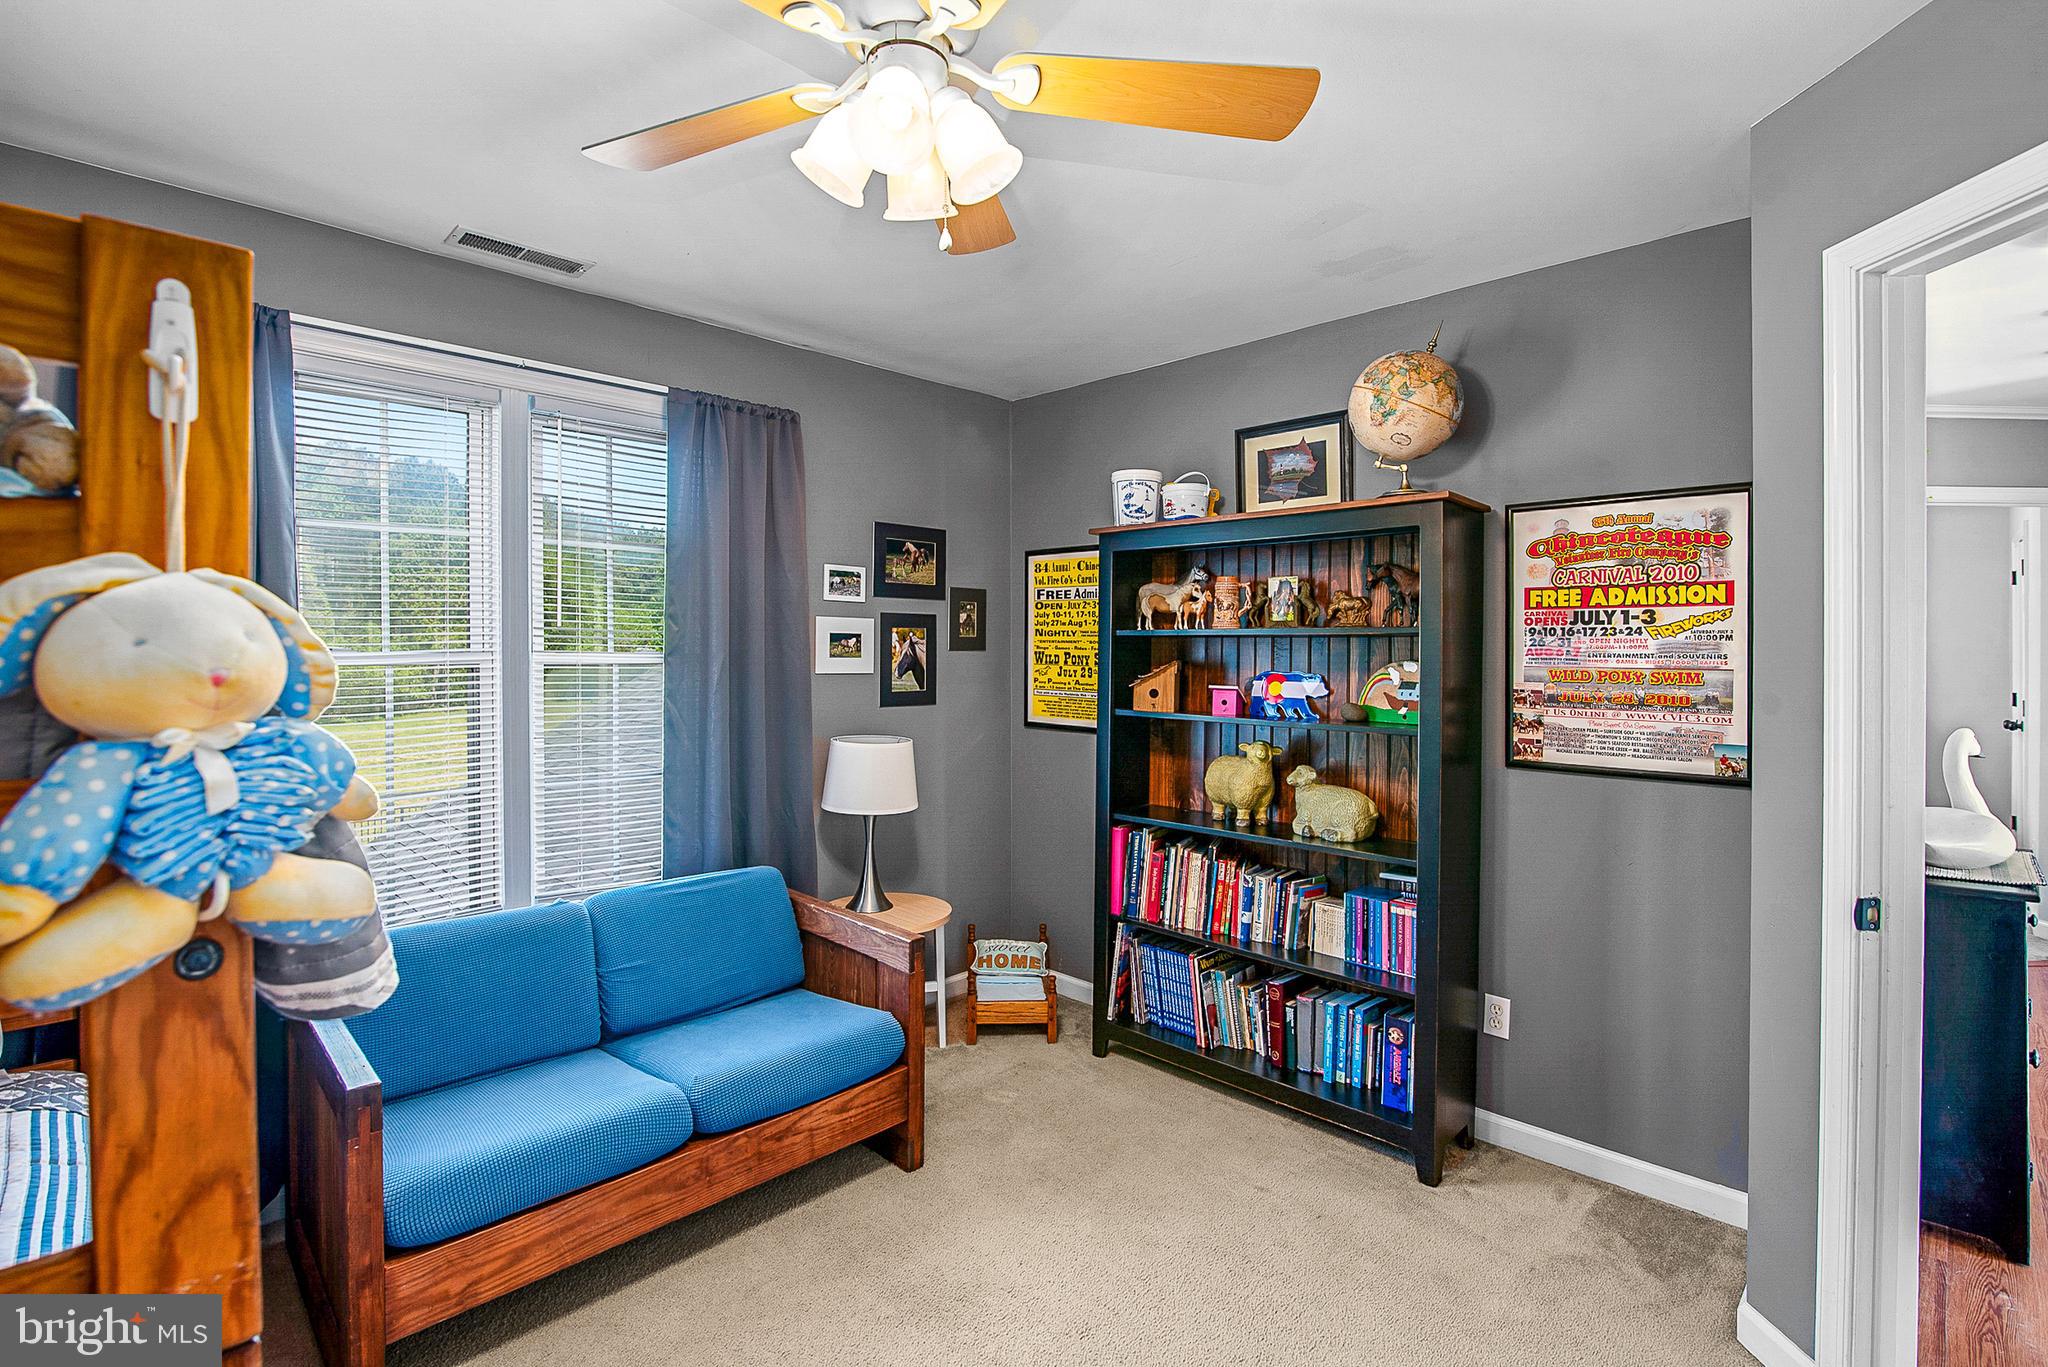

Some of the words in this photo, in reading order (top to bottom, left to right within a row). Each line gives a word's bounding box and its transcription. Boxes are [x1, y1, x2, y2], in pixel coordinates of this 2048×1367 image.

[1616, 512, 1654, 525] Annual
[1526, 525, 1732, 558] Chincoteague
[1607, 546, 1633, 560] Fire
[1554, 565, 1645, 586] CARNIVAL
[1649, 564, 1699, 582] 2010
[1036, 589, 1072, 599] FREE
[1529, 588, 1581, 608] FREE
[1589, 583, 1726, 606] ADMISSION
[1034, 611, 1050, 619] July
[1524, 616, 1568, 626] OPENS
[1569, 610, 1617, 625] JULY
[1621, 609, 1657, 625] 1-3
[1034, 619, 1050, 627] July
[1067, 619, 1083, 628] Aug
[1645, 607, 1733, 640] FIREWORKS
[1034, 651, 1060, 665] WILD
[1064, 652, 1090, 666] PONY
[1548, 669, 1593, 683] WILD
[1596, 669, 1646, 684] PONY
[1649, 671, 1704, 685] SWIM
[1558, 691, 1605, 704] JULY
[1644, 693, 1692, 706] 2010
[1569, 709, 1608, 717] ONLINE
[985, 945, 1031, 953] sweet
[977, 953, 1042, 969] HOME
